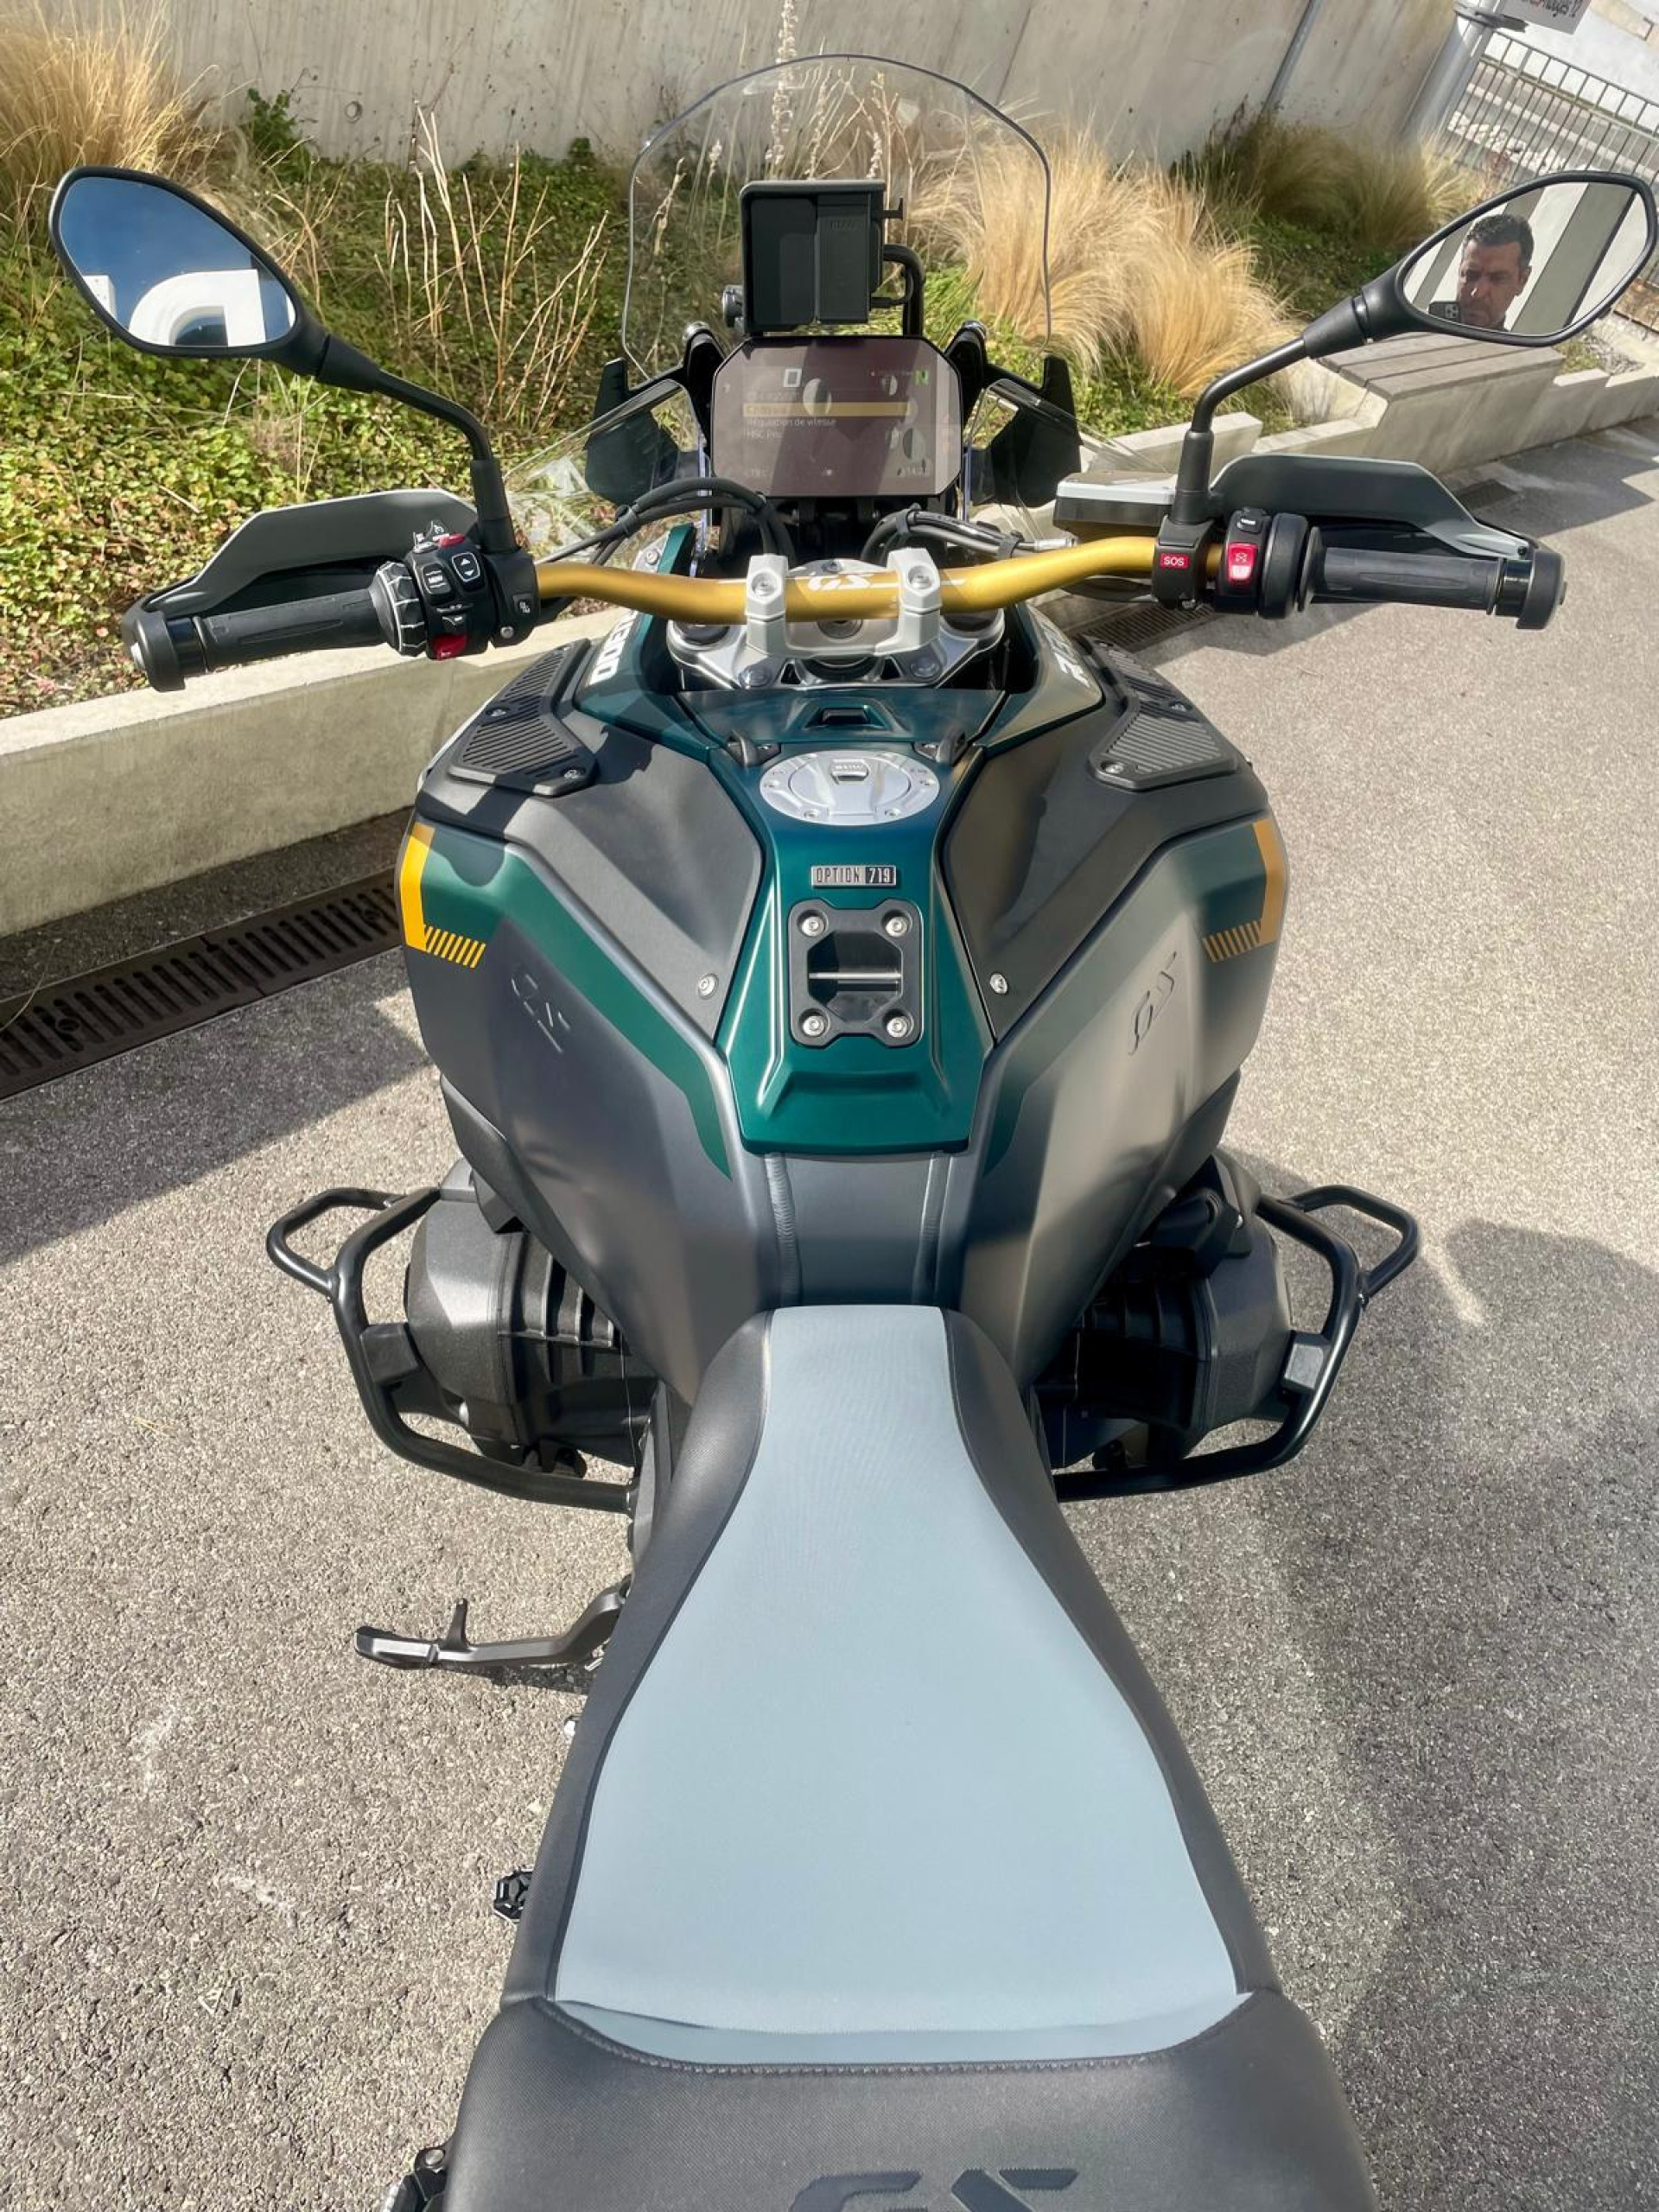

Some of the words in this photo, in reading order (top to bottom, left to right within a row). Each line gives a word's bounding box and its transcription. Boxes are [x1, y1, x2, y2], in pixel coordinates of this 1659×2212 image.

[1163, 556, 1185, 567] SOS
[817, 868, 861, 883] OPTION
[869, 868, 890, 883] 719
